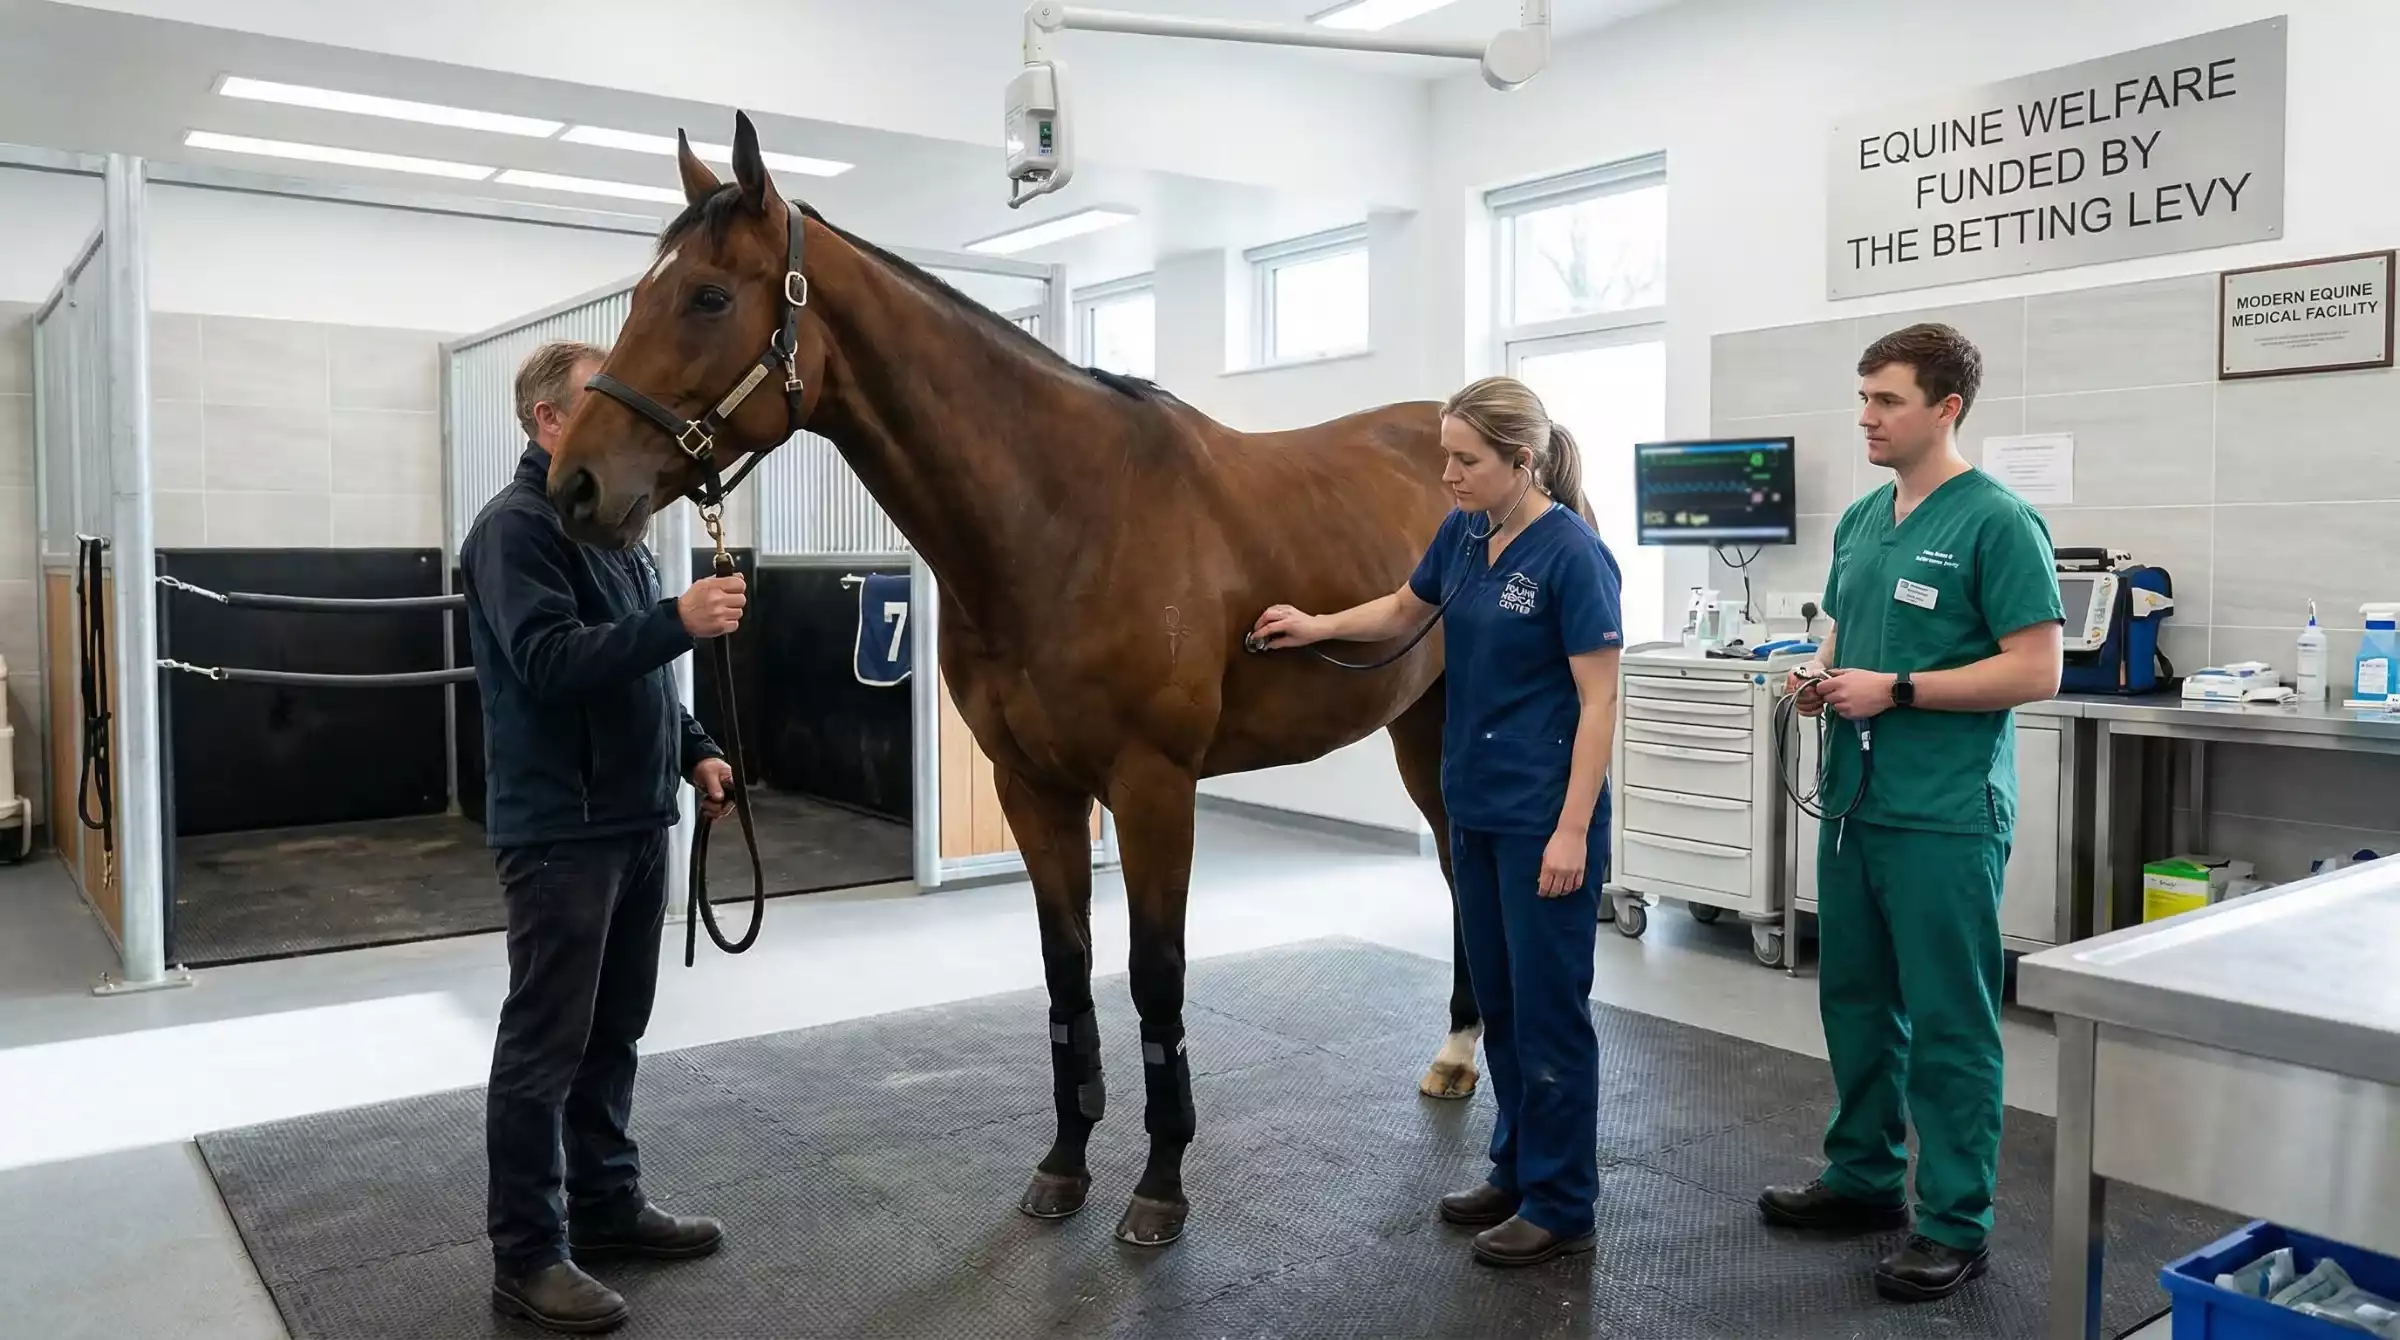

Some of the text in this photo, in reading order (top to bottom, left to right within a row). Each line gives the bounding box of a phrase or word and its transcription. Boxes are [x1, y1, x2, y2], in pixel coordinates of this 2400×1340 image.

[1860, 57, 2237, 170] EQUINE WELFARE
[1917, 130, 2162, 209] FUNDED BY
[1847, 172, 2252, 270] THE BETTING LEVY
[2232, 300, 2379, 328] MEDICAL FACILITY
[2236, 282, 2373, 310] MODERN EQUINE
[884, 602, 908, 662] 7
